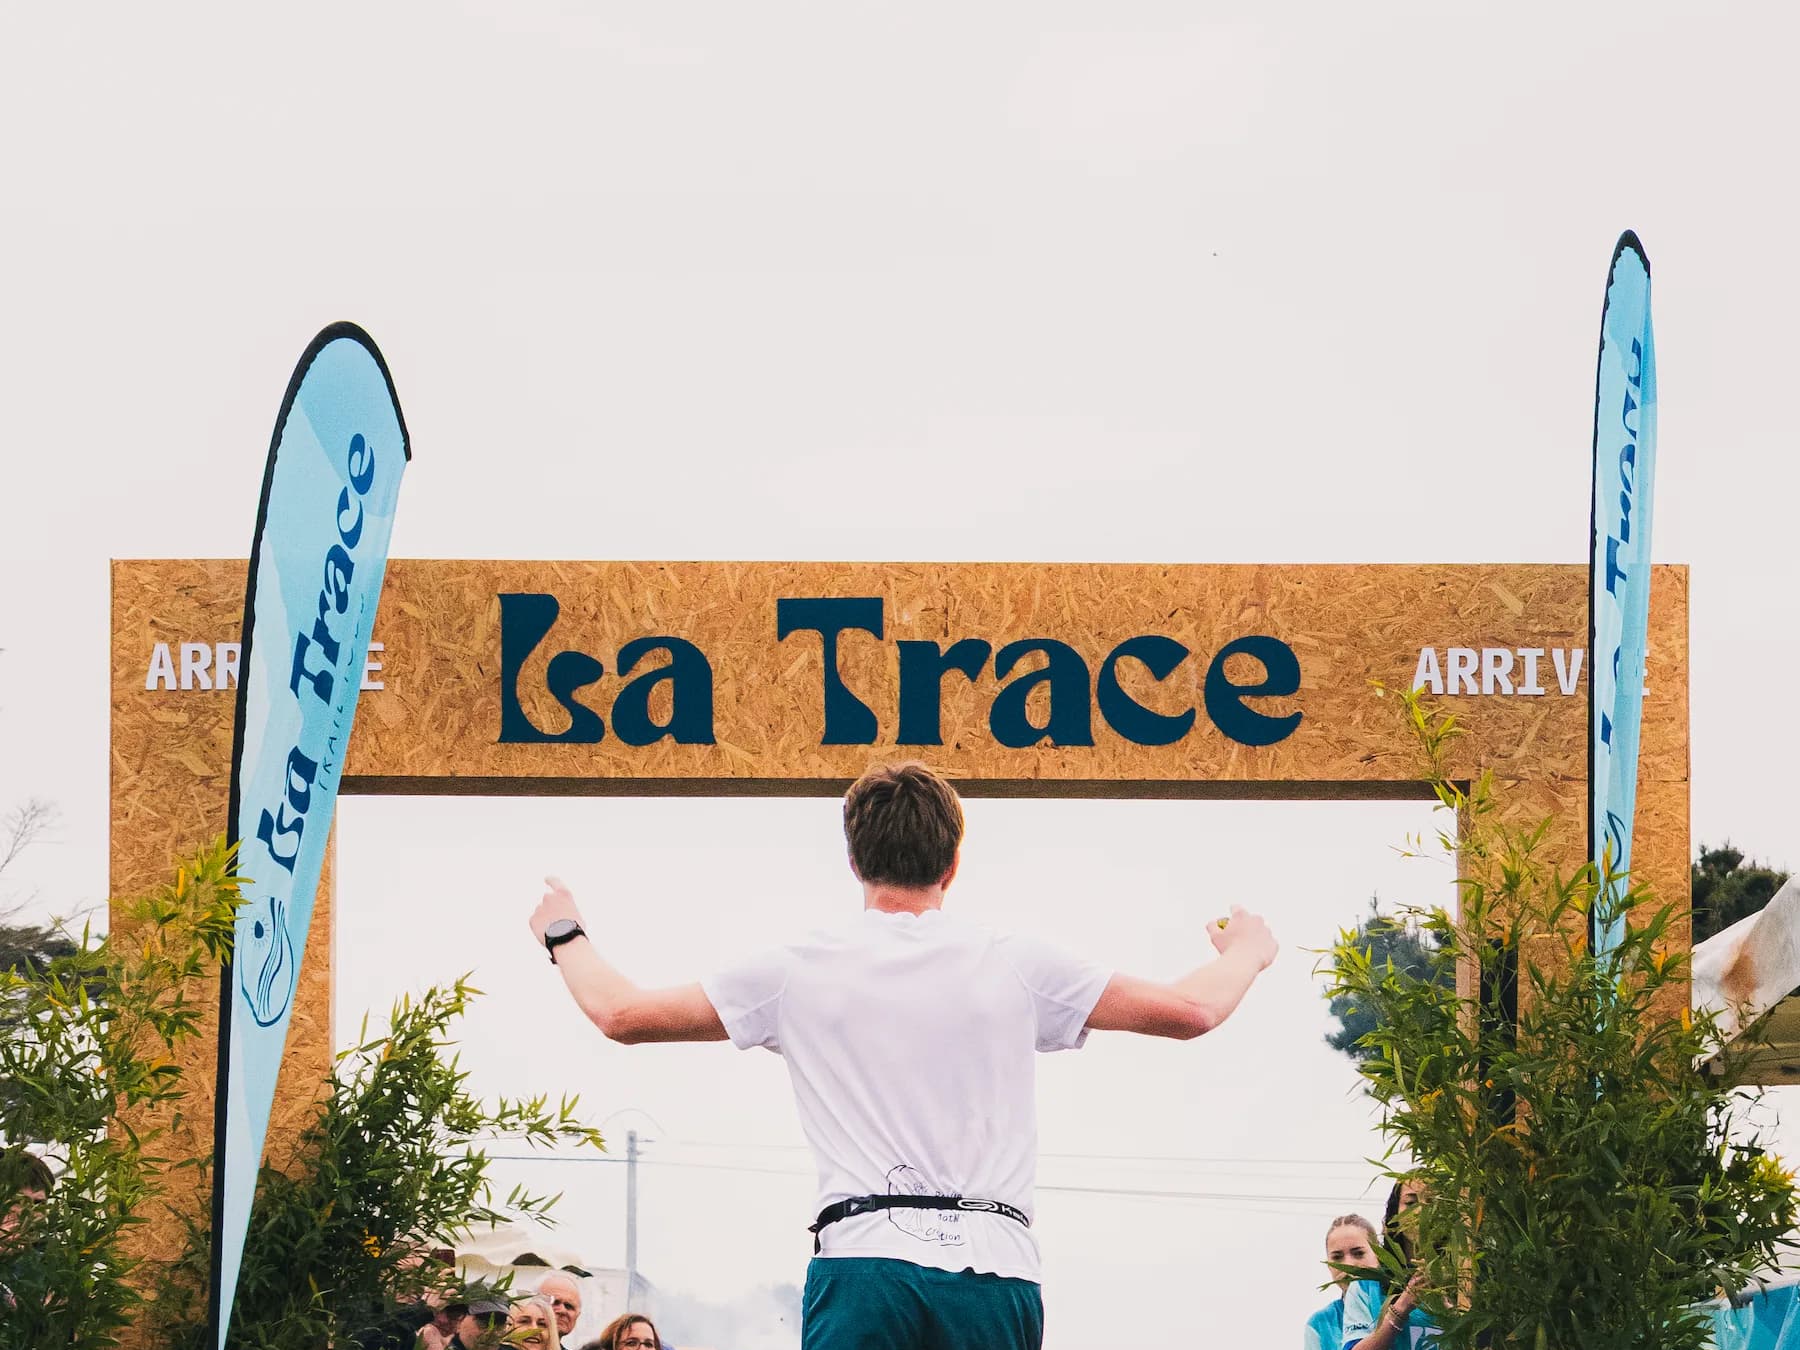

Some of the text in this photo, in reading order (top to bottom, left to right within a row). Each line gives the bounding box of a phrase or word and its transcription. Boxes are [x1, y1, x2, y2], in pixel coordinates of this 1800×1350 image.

[145, 642, 385, 691] ARRE
[256, 433, 375, 877] La Trace
[498, 594, 717, 747] La
[777, 597, 1304, 748] Trace
[1412, 647, 1650, 696] ARRIV
